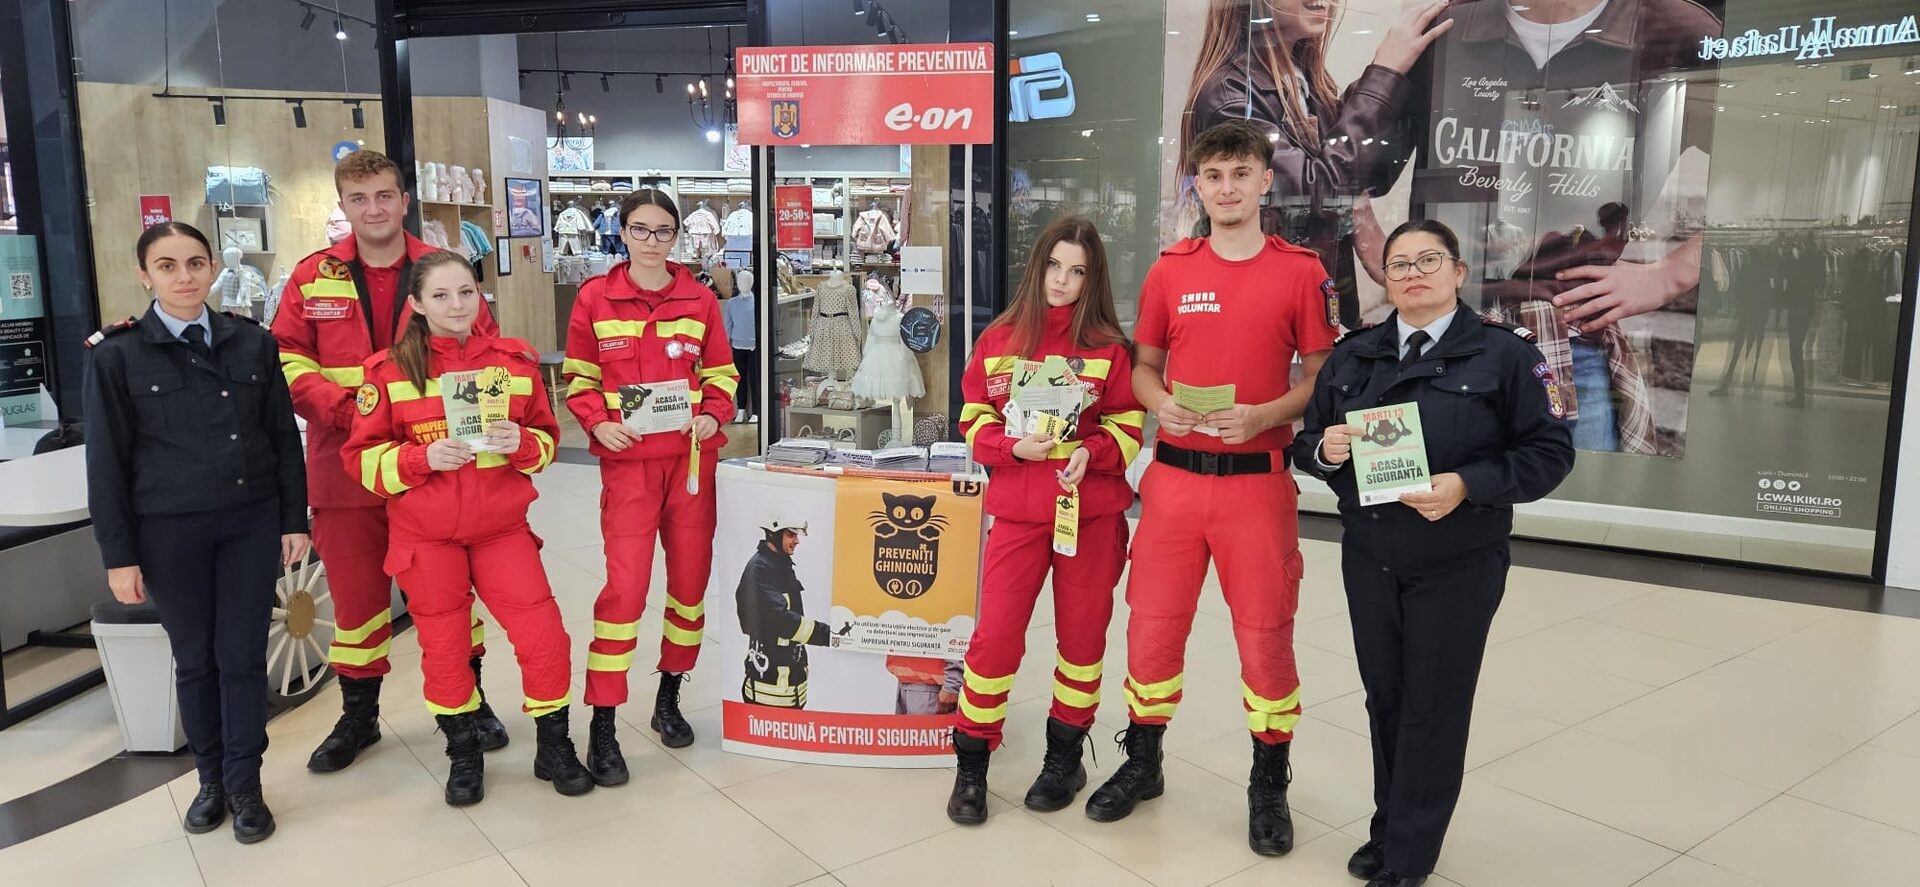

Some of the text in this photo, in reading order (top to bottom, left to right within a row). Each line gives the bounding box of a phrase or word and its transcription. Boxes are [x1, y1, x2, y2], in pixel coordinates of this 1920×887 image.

[742, 47, 987, 73] PUNCT DE INFORMARE PREVENTIVĂ
[1462, 77, 1508, 90] Los Angeles
[1473, 88, 1500, 101] County
[1435, 117, 1635, 170] CALIFORNIA
[1457, 165, 1601, 202] Beverly Hills
[1181, 292, 1216, 304] SMURD
[1177, 303, 1221, 314] VOLUNTAR
[1395, 408, 1404, 418] 13
[460, 415, 482, 426] ACAS
[1366, 466, 1423, 485] SIGURANȚĂ
[1757, 493, 1842, 507] LCWAIKIKI.RO
[1763, 504, 1834, 515] ONLINE SHOPPING
[879, 546, 933, 563] PREVENIȚI
[875, 560, 935, 575] GHINIONUL
[912, 642, 941, 651] SIGURANȚĂ
[748, 715, 954, 750] ÎMPREUNĂ PENTRU SIGURANȚĂ
